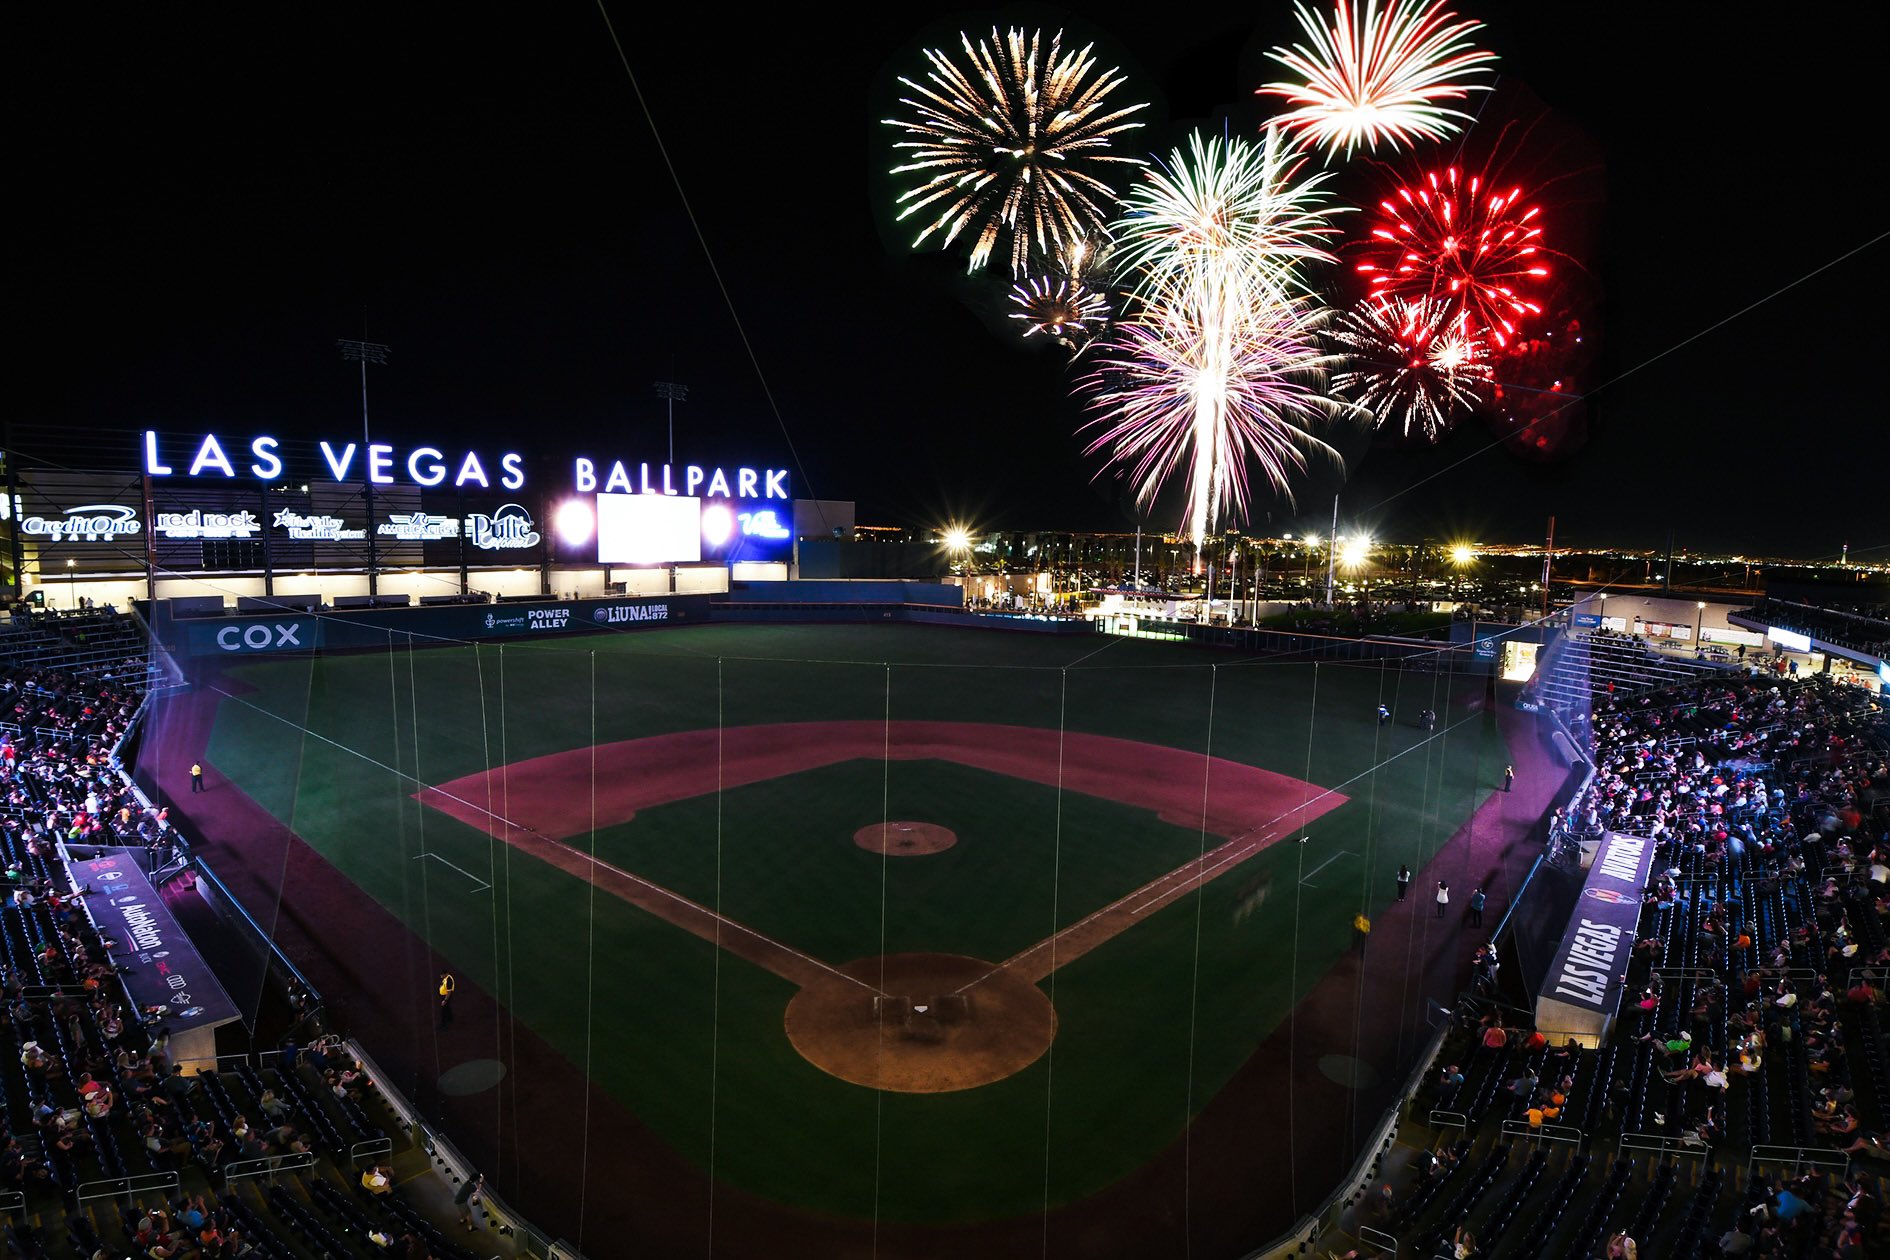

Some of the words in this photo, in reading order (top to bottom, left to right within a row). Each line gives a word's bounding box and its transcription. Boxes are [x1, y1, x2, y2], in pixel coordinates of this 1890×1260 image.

[146, 430, 282, 479] LAS
[319, 441, 524, 490] VEGAS
[576, 457, 788, 500] BALLPARK
[157, 509, 200, 528] red
[203, 509, 261, 528] rock
[468, 514, 531, 545] Pulte
[528, 609, 570, 619] POWER
[651, 604, 668, 612] LOCAL
[217, 623, 300, 650] COX
[530, 619, 568, 629] ALLEY
[120, 903, 162, 950] AutoNation
[1567, 918, 1621, 971] VEGAS
[1555, 963, 1608, 1006] LAS
